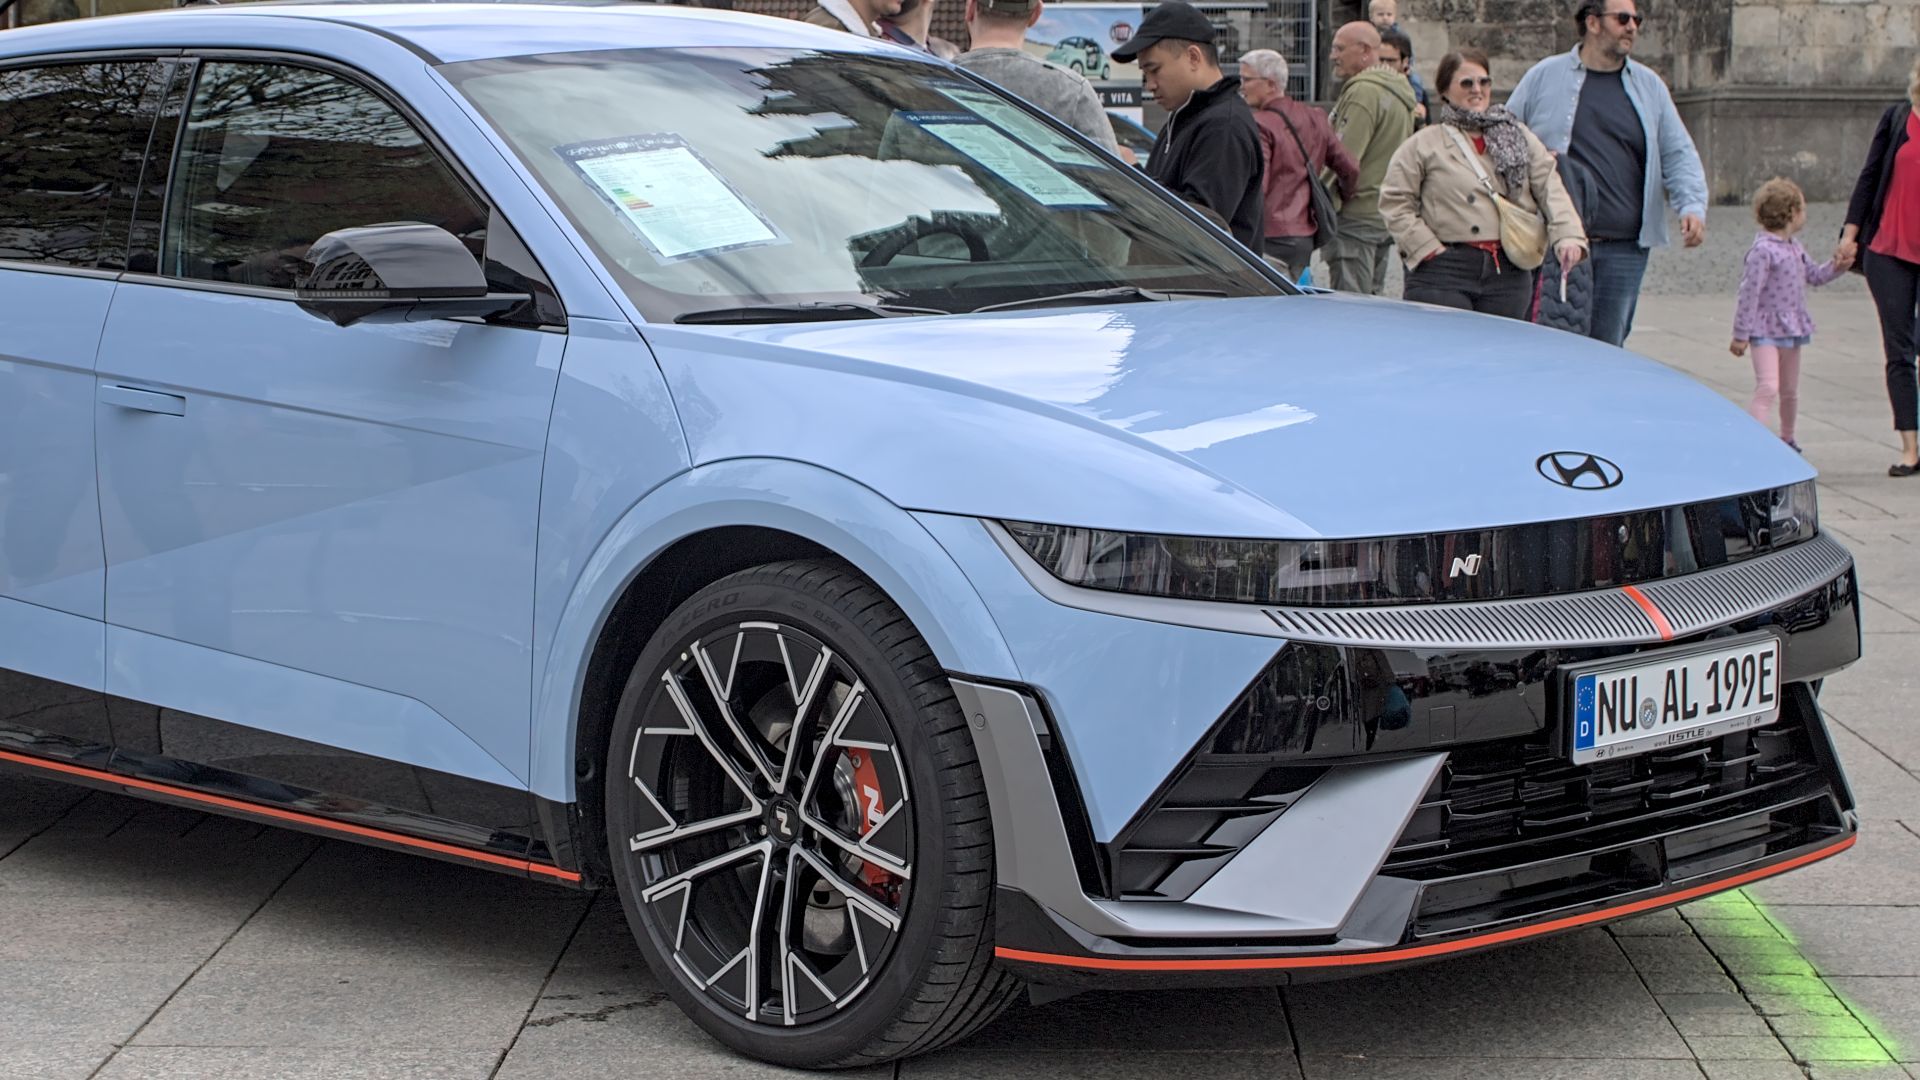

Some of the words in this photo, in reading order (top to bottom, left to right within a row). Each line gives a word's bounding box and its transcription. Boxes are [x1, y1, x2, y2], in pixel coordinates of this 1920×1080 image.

[1111, 92, 1133, 104] VITA
[1598, 676, 1637, 737] NU
[1662, 667, 1698, 724] AL
[1706, 650, 1774, 715] 199E
[1580, 721, 1590, 738] D
